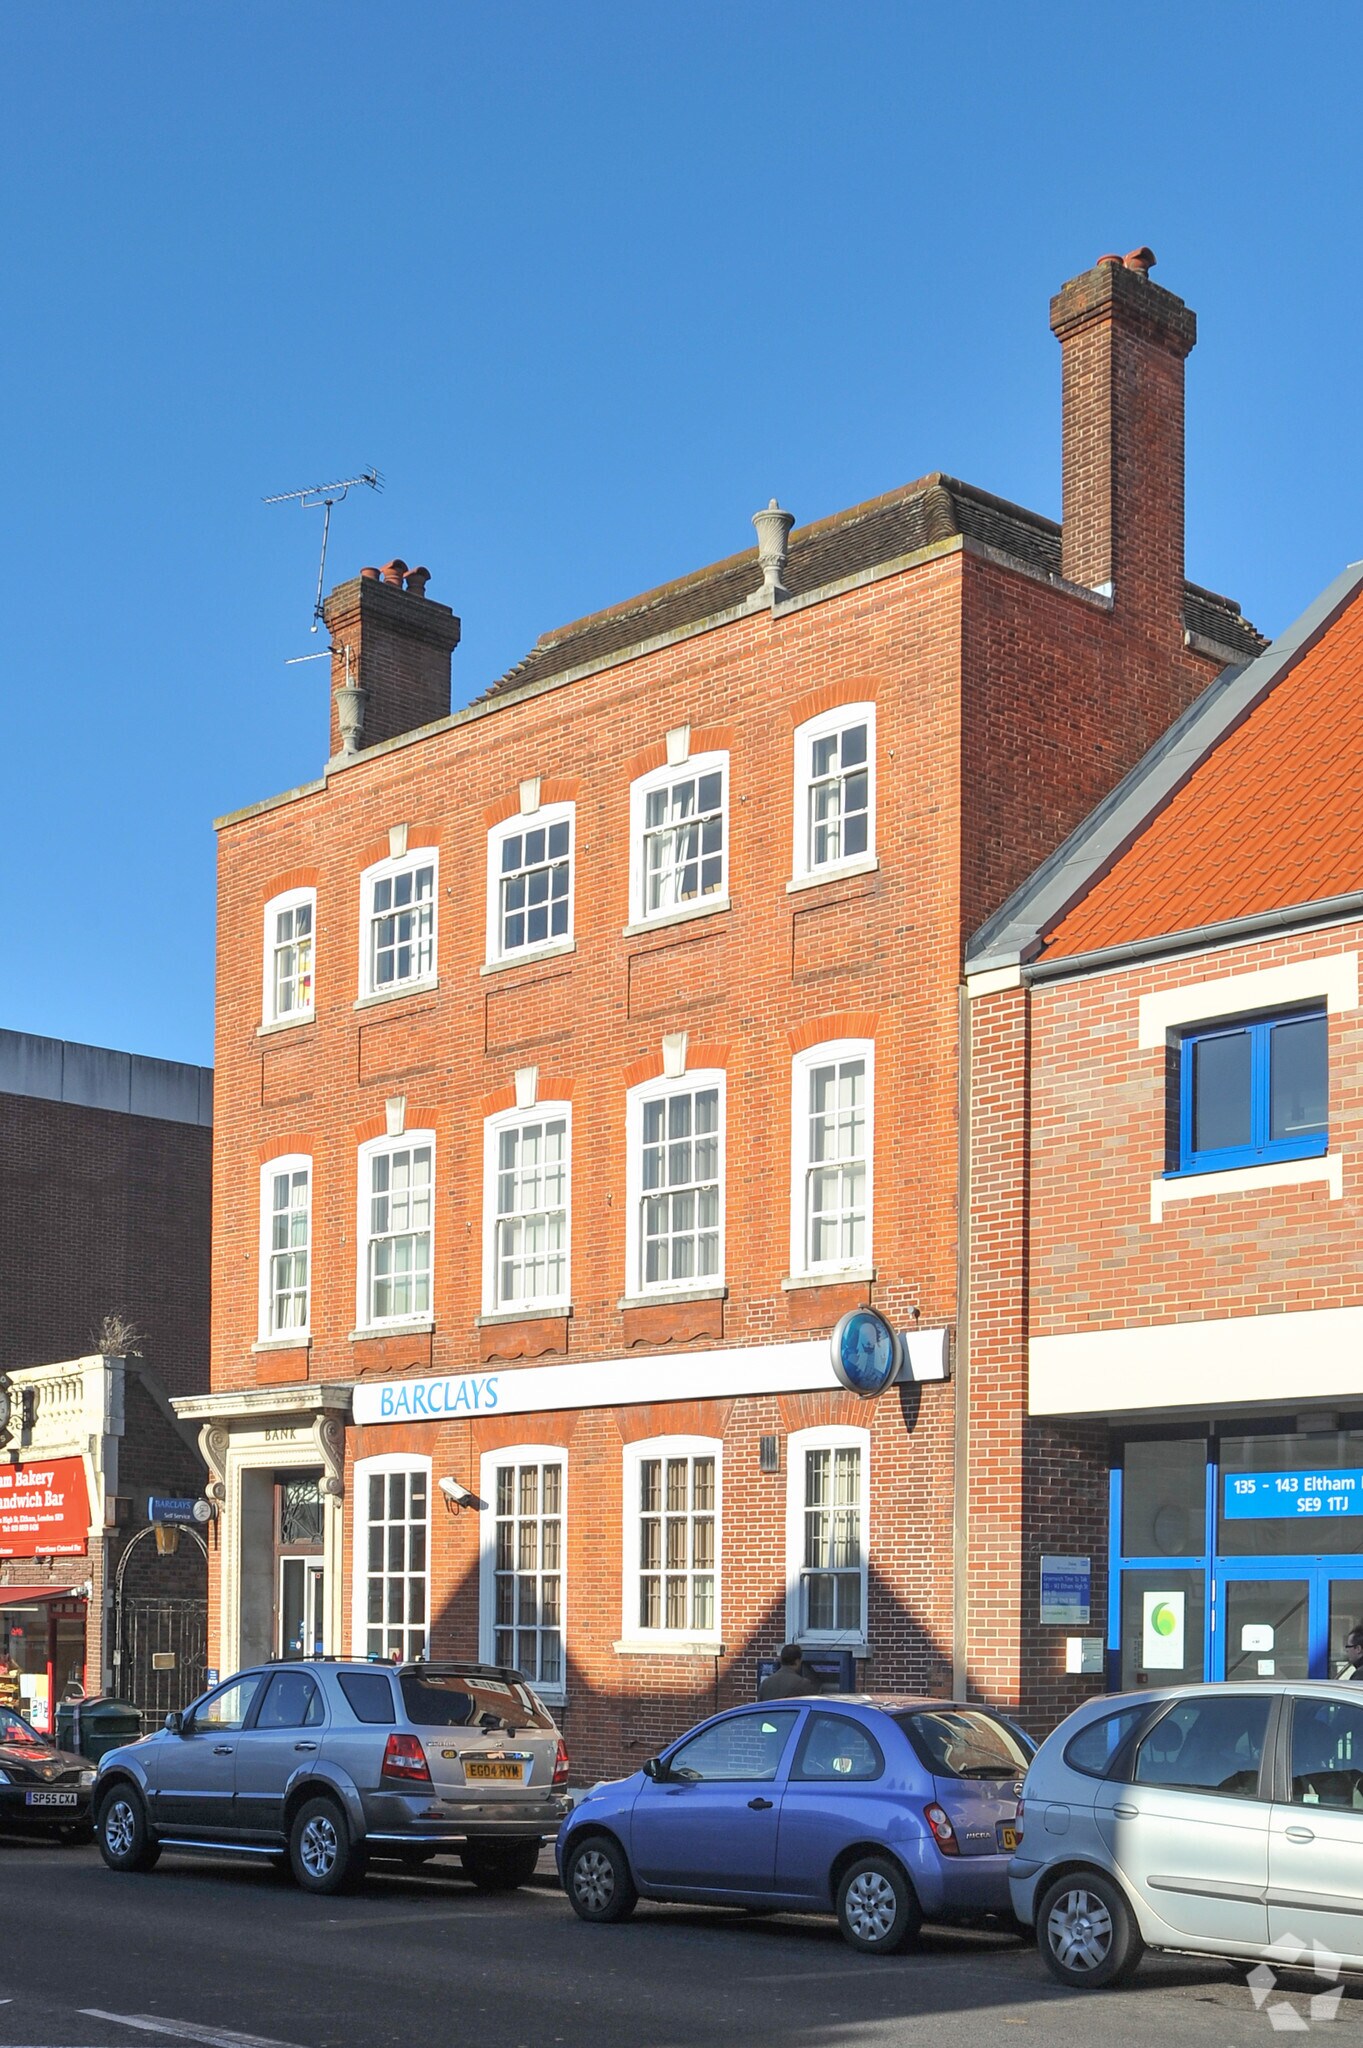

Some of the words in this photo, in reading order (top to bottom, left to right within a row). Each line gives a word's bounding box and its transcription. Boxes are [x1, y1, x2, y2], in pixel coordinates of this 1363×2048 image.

[380, 1377, 498, 1416] BARCLAYS
[265, 1427, 296, 1441] BANK
[15, 1470, 54, 1488] Bakery
[1233, 1480, 1256, 1494] 135
[1275, 1478, 1299, 1492] 143
[1304, 1476, 1355, 1491] Eltham
[44, 1490, 64, 1507] Bar
[155, 1500, 191, 1509] BARCLAYS
[1296, 1497, 1321, 1512] SE9
[1327, 1496, 1349, 1511] 1TJ
[470, 1764, 496, 1777] EG04
[32, 1794, 57, 1804] SP55
[58, 1794, 76, 1804] CXA
